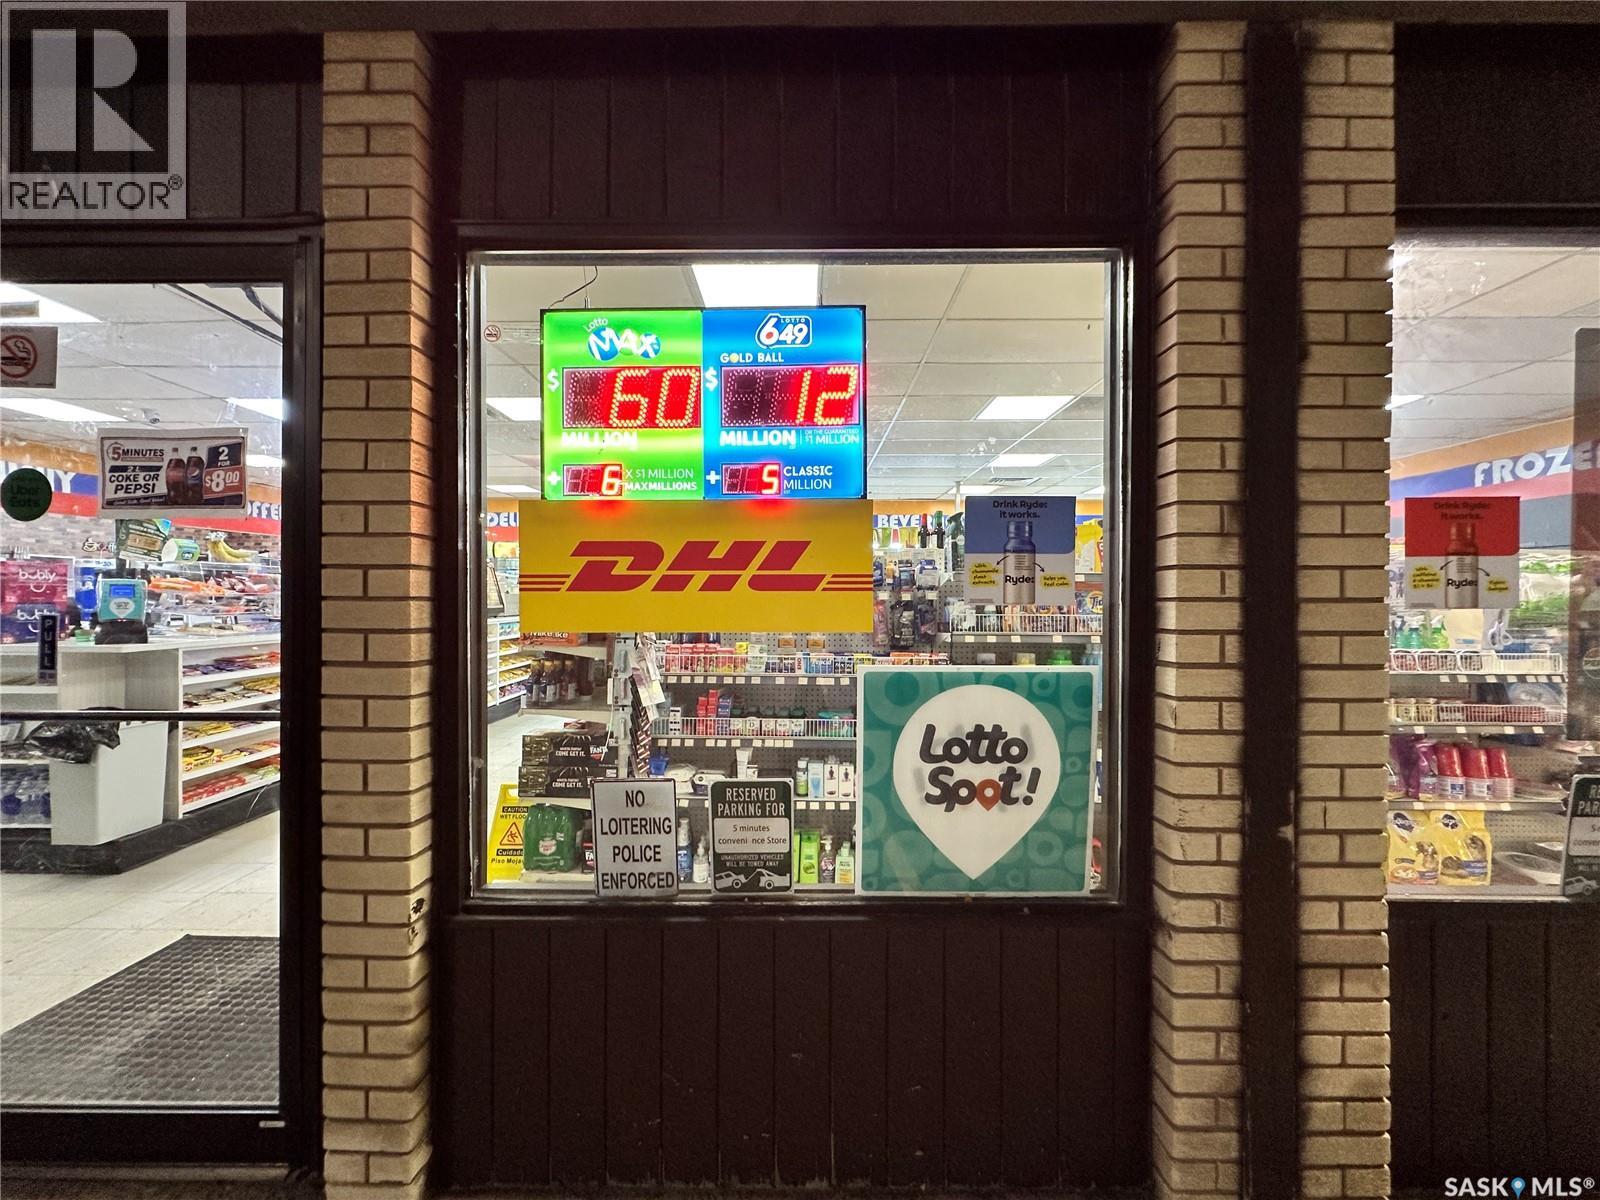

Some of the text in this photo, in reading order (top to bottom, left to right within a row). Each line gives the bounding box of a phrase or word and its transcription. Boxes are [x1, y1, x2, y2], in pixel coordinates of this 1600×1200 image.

[583, 317, 609, 332] Lotto
[719, 352, 785, 364] GOLD BALL
[561, 431, 639, 448] MILLION
[719, 429, 797, 447] MILLION
[815, 434, 860, 445] MILLION
[121, 448, 165, 457] MINUTES
[218, 446, 229, 461] 2
[217, 460, 231, 468] FOR
[783, 465, 833, 476] CLASSIC
[108, 473, 160, 484] COKE OR
[648, 468, 694, 479] MILLION
[113, 482, 156, 495] PEPSI
[624, 481, 698, 491] MAXMILLIONS
[783, 478, 833, 490] MILLION
[992, 500, 1018, 509] Drink
[1433, 502, 1460, 510] Drink
[999, 511, 1041, 519] it works.
[565, 540, 828, 592] DHL
[18, 568, 57, 583] bubly
[44, 618, 54, 667] PULL
[919, 723, 1029, 765] Lotto
[725, 787, 777, 801] RESERVED
[924, 766, 1042, 813] Spot!
[625, 789, 646, 808] NO
[717, 802, 786, 817] PARKING FOR
[600, 816, 673, 836] LOITERING
[739, 824, 770, 832] minutes
[766, 836, 787, 845] Store
[612, 844, 662, 863] POLICE
[506, 857, 523, 865] Moja
[601, 871, 675, 890] ENFORCED
